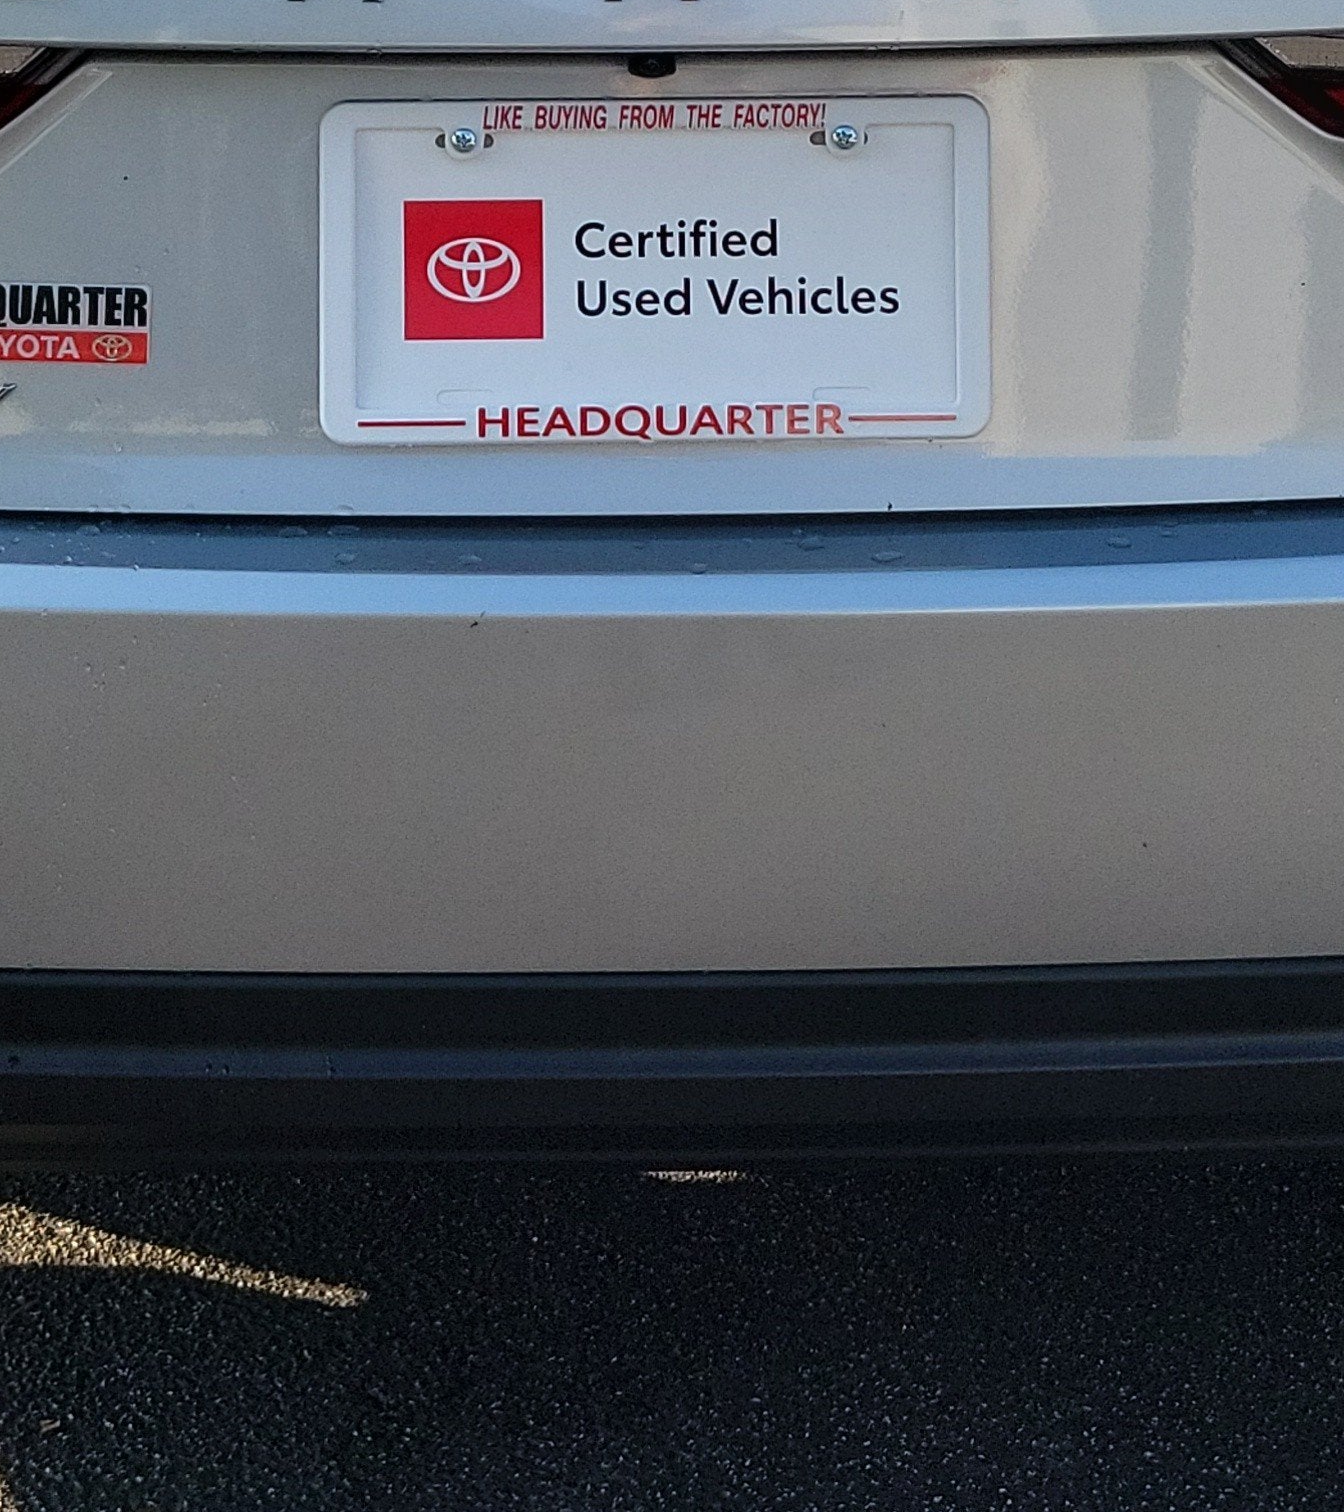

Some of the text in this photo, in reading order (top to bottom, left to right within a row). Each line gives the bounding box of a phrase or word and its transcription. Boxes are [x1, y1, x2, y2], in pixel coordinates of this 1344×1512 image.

[482, 102, 827, 130] LIKE BUYING FROM THE FACTORY!
[574, 218, 778, 258] Certified
[577, 276, 900, 316] Used Vehicles
[477, 403, 845, 441] HEADQUARTER
